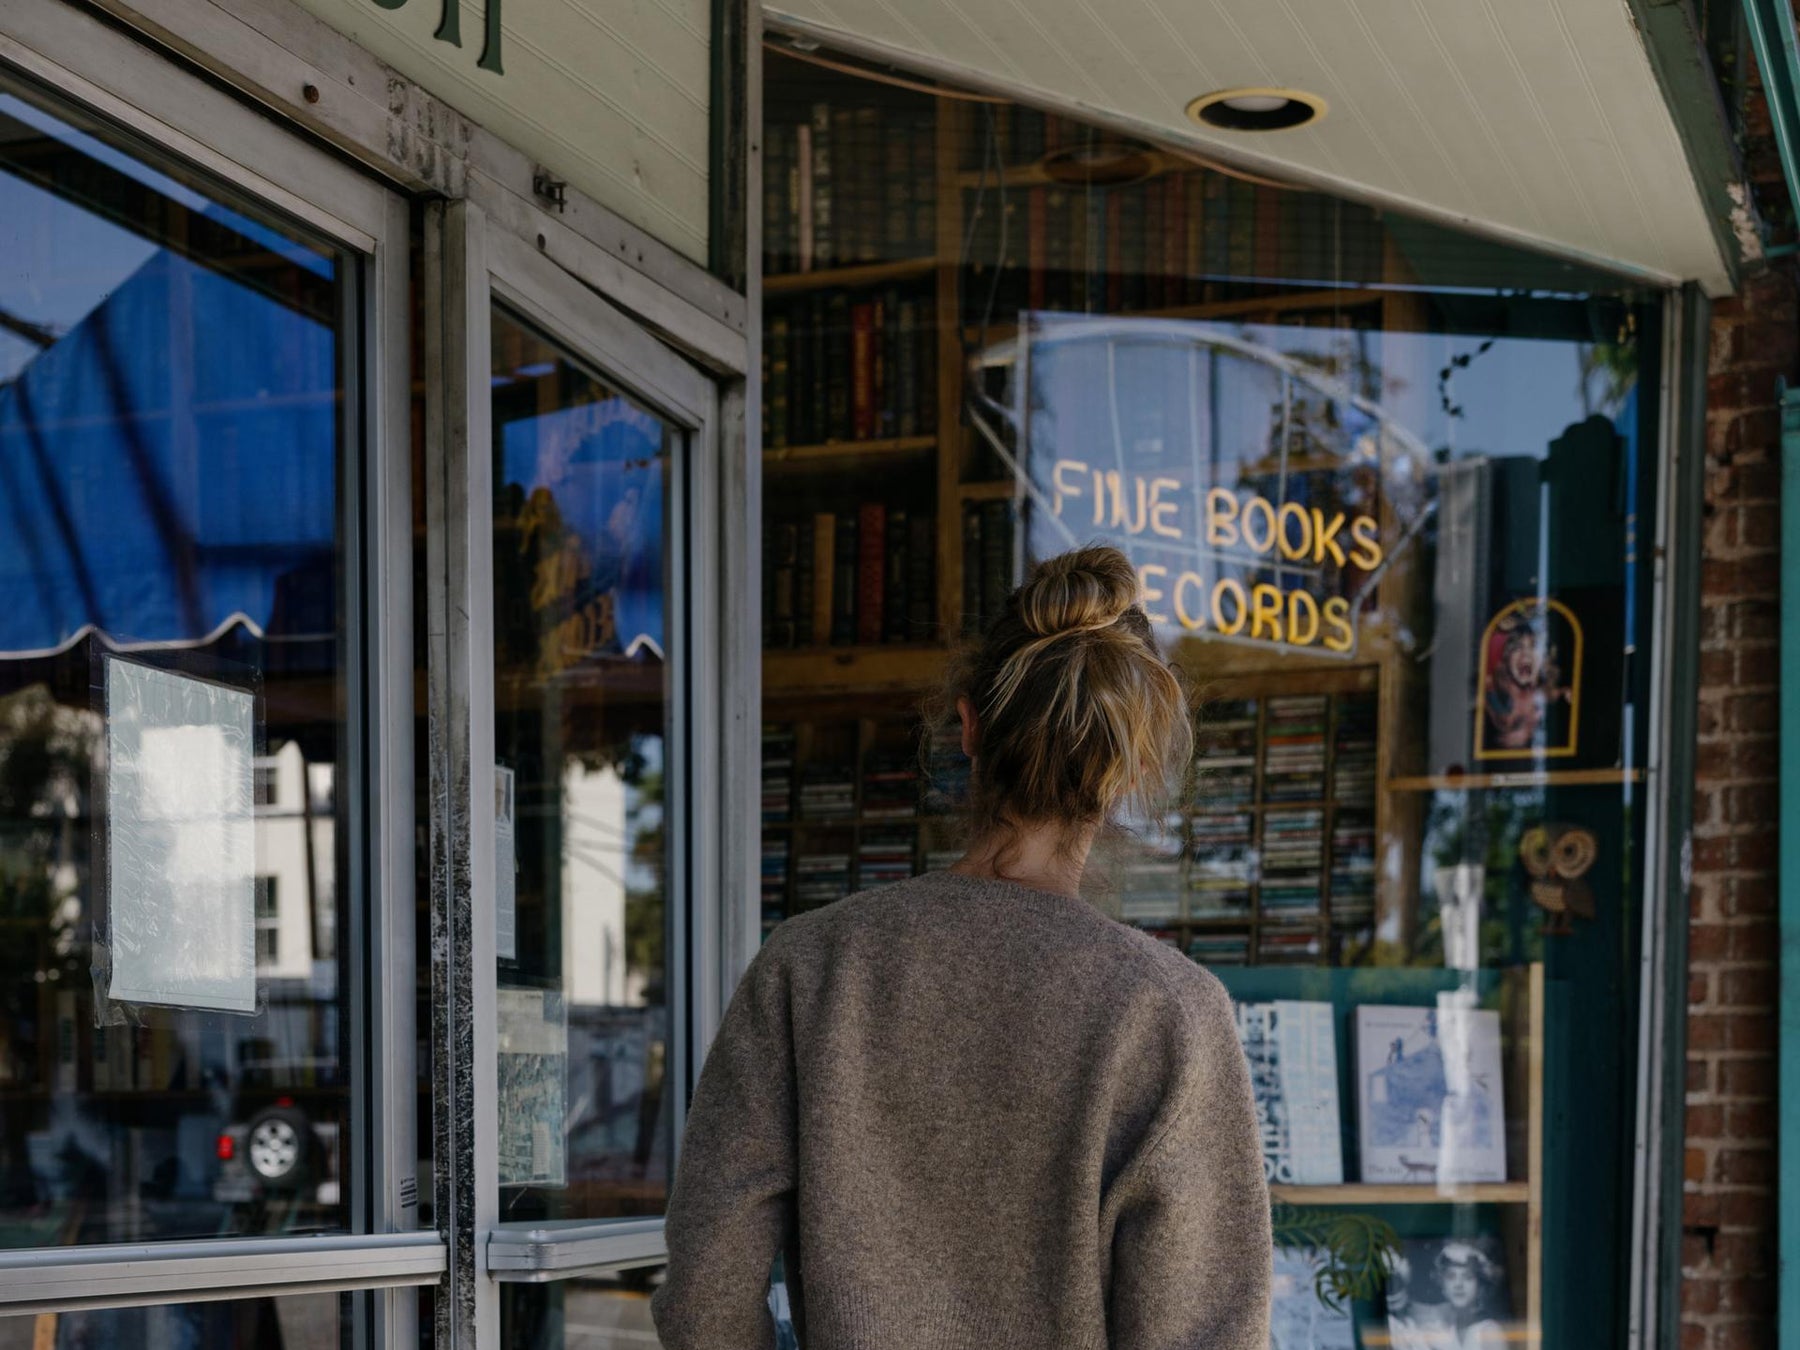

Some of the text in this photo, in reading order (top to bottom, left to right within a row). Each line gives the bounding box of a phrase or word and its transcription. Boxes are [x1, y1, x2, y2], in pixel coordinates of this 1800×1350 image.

[1053, 460, 1382, 571] FINE BOOKS
[1139, 564, 1354, 652] ECORDS
